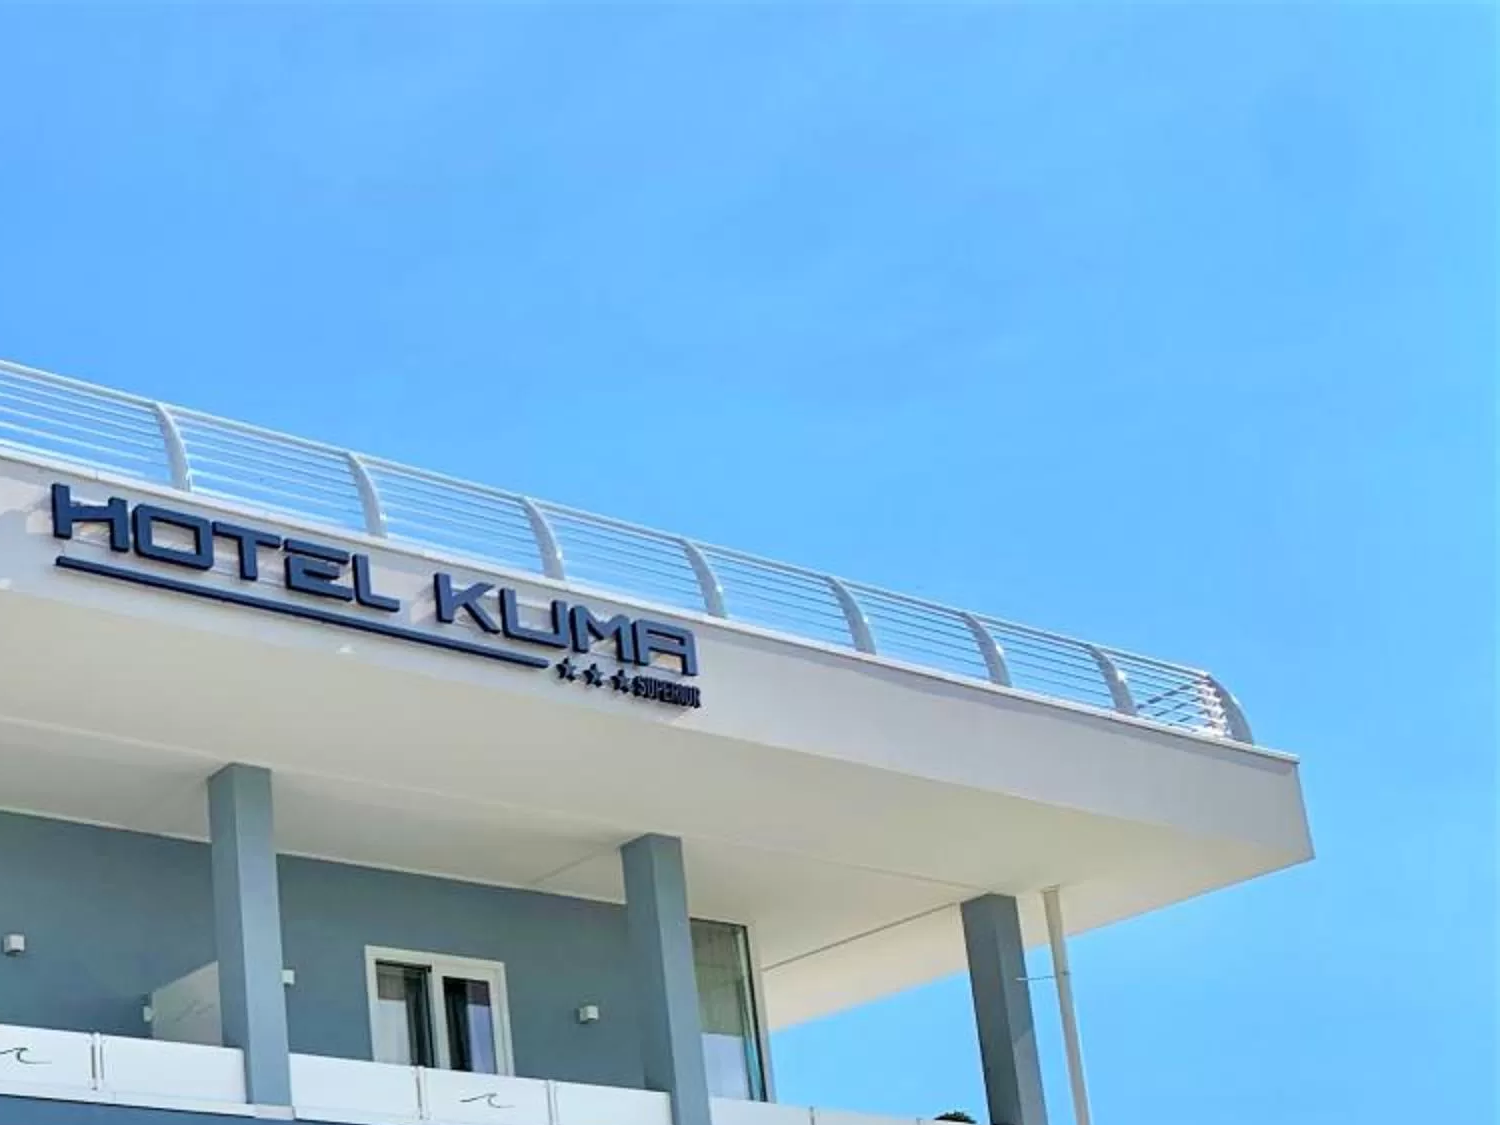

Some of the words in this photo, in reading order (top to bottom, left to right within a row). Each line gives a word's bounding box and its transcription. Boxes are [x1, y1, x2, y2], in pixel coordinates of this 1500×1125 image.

[51, 482, 400, 613] HOTEL
[433, 571, 699, 677] KUMA
[632, 675, 701, 709] SUPERIOR
